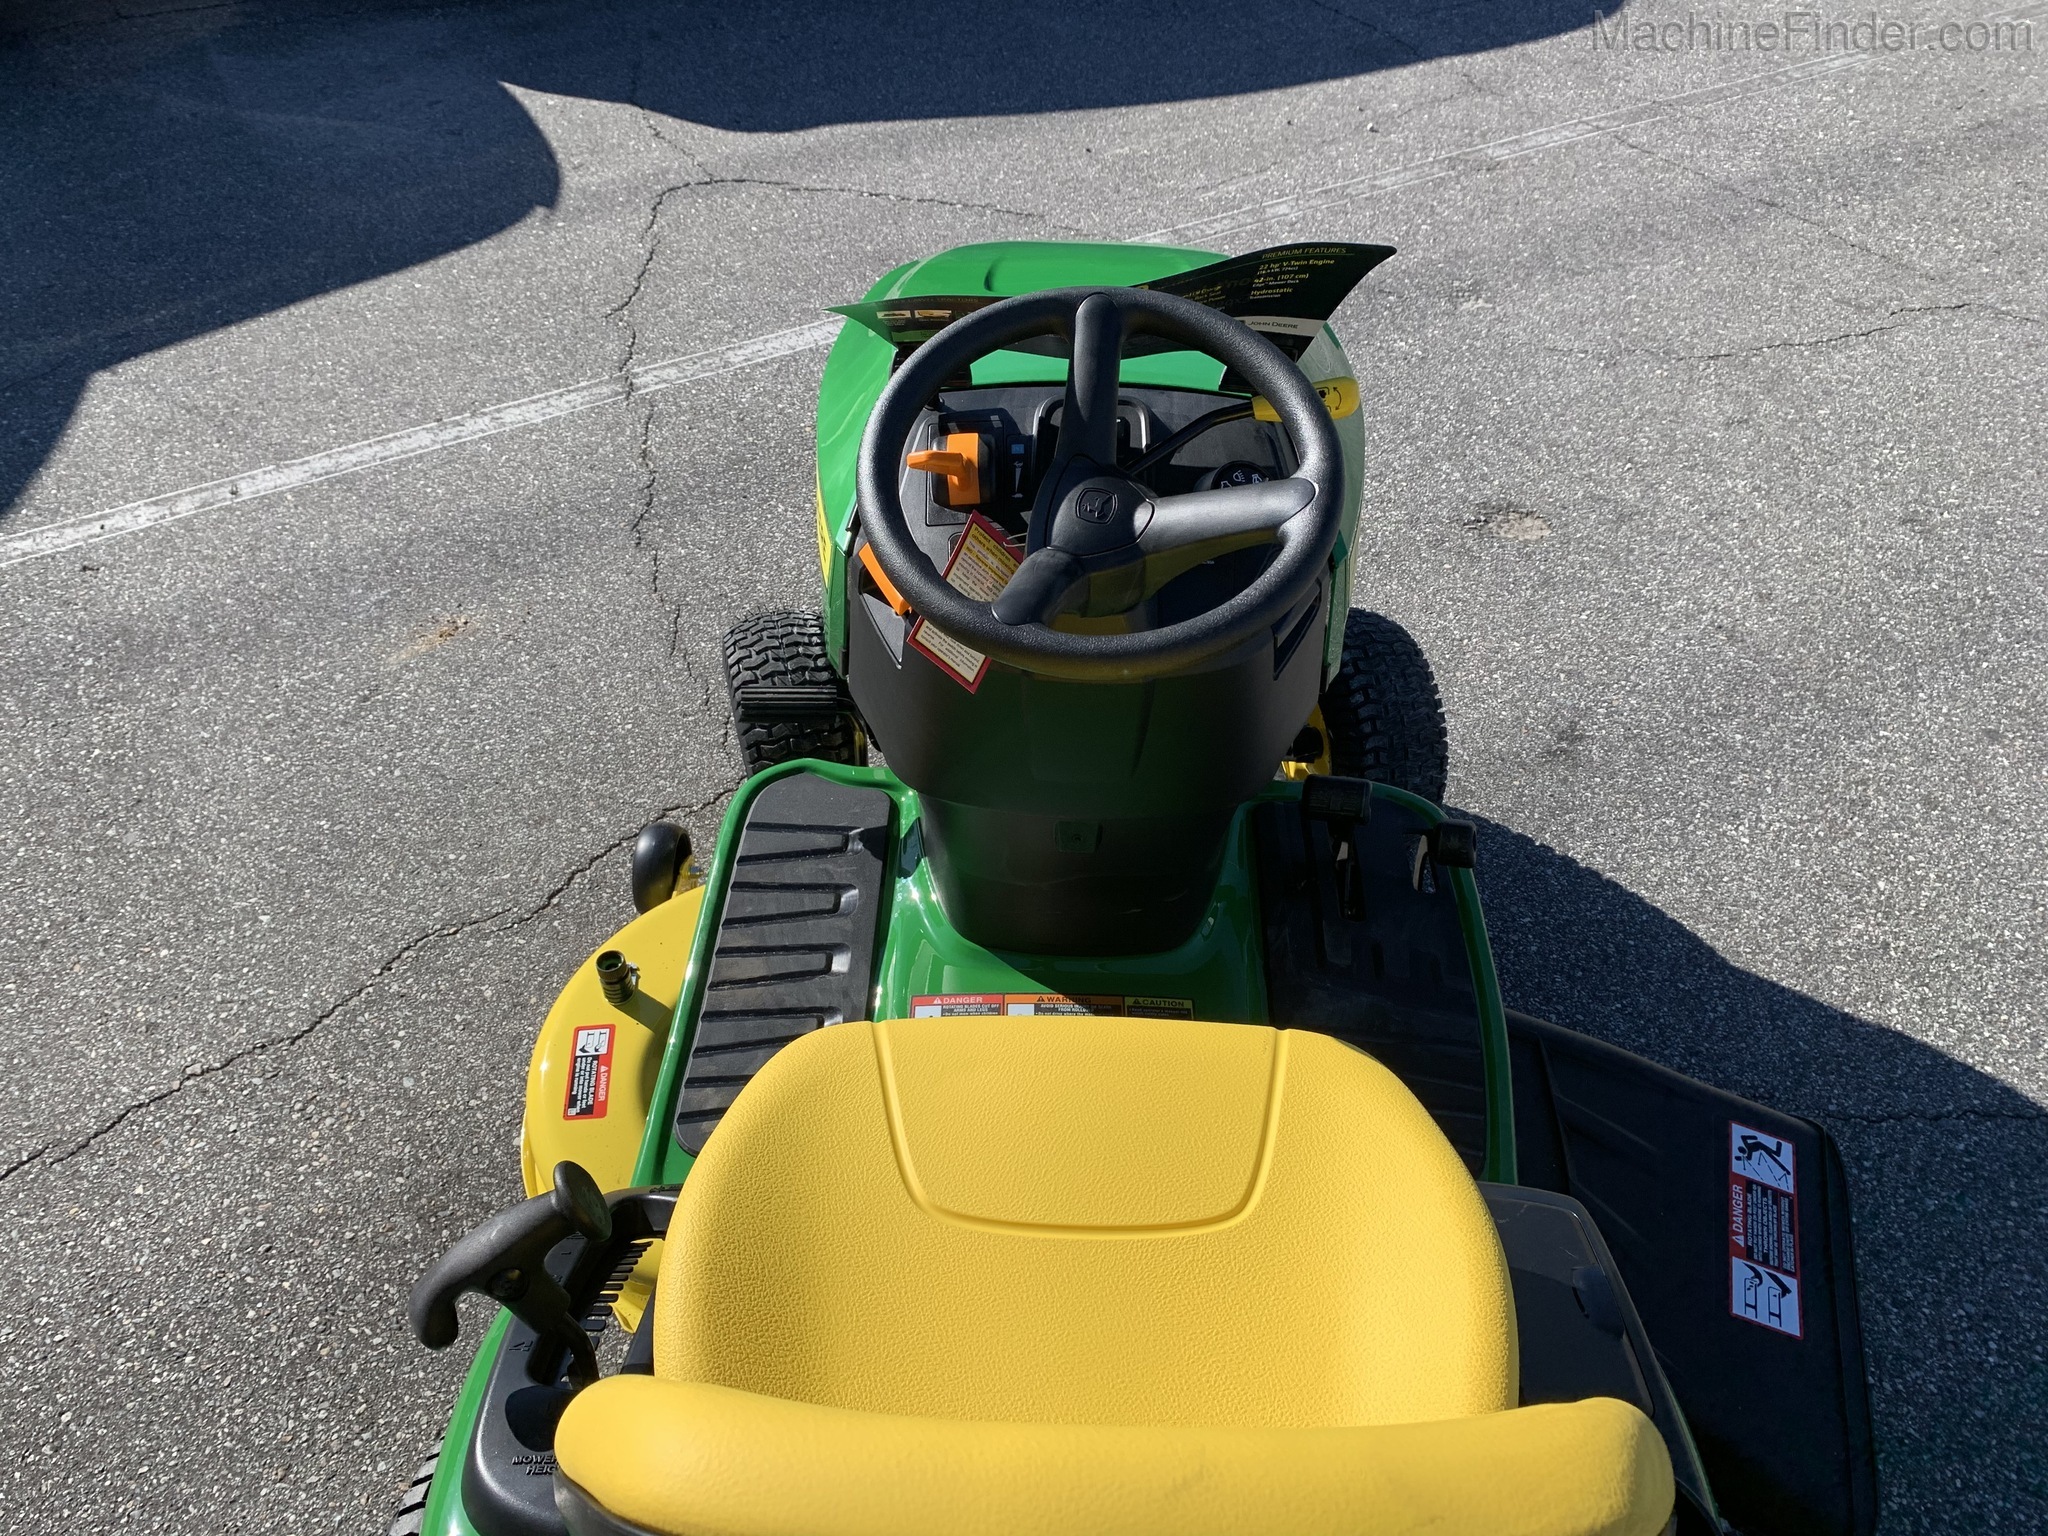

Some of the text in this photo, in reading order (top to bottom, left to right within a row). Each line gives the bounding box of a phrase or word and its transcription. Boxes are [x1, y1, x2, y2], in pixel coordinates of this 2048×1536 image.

[1262, 247, 1347, 259] PREMIUM FEATURES
[1283, 259, 1308, 267] V-Twin
[1309, 258, 1335, 266] Engine
[1250, 286, 1294, 297] Hydrostatic
[1271, 321, 1299, 329] DEERE
[971, 533, 986, 547] others
[985, 546, 998, 558] when
[974, 526, 1011, 562] Protect children
[944, 646, 958, 659] additional
[943, 996, 983, 1004] DANGER
[1142, 998, 1184, 1007] CAUTION
[590, 1060, 598, 1086] ROTATING
[598, 1073, 607, 1101] DANGER
[1732, 1184, 1743, 1233] DANGER
